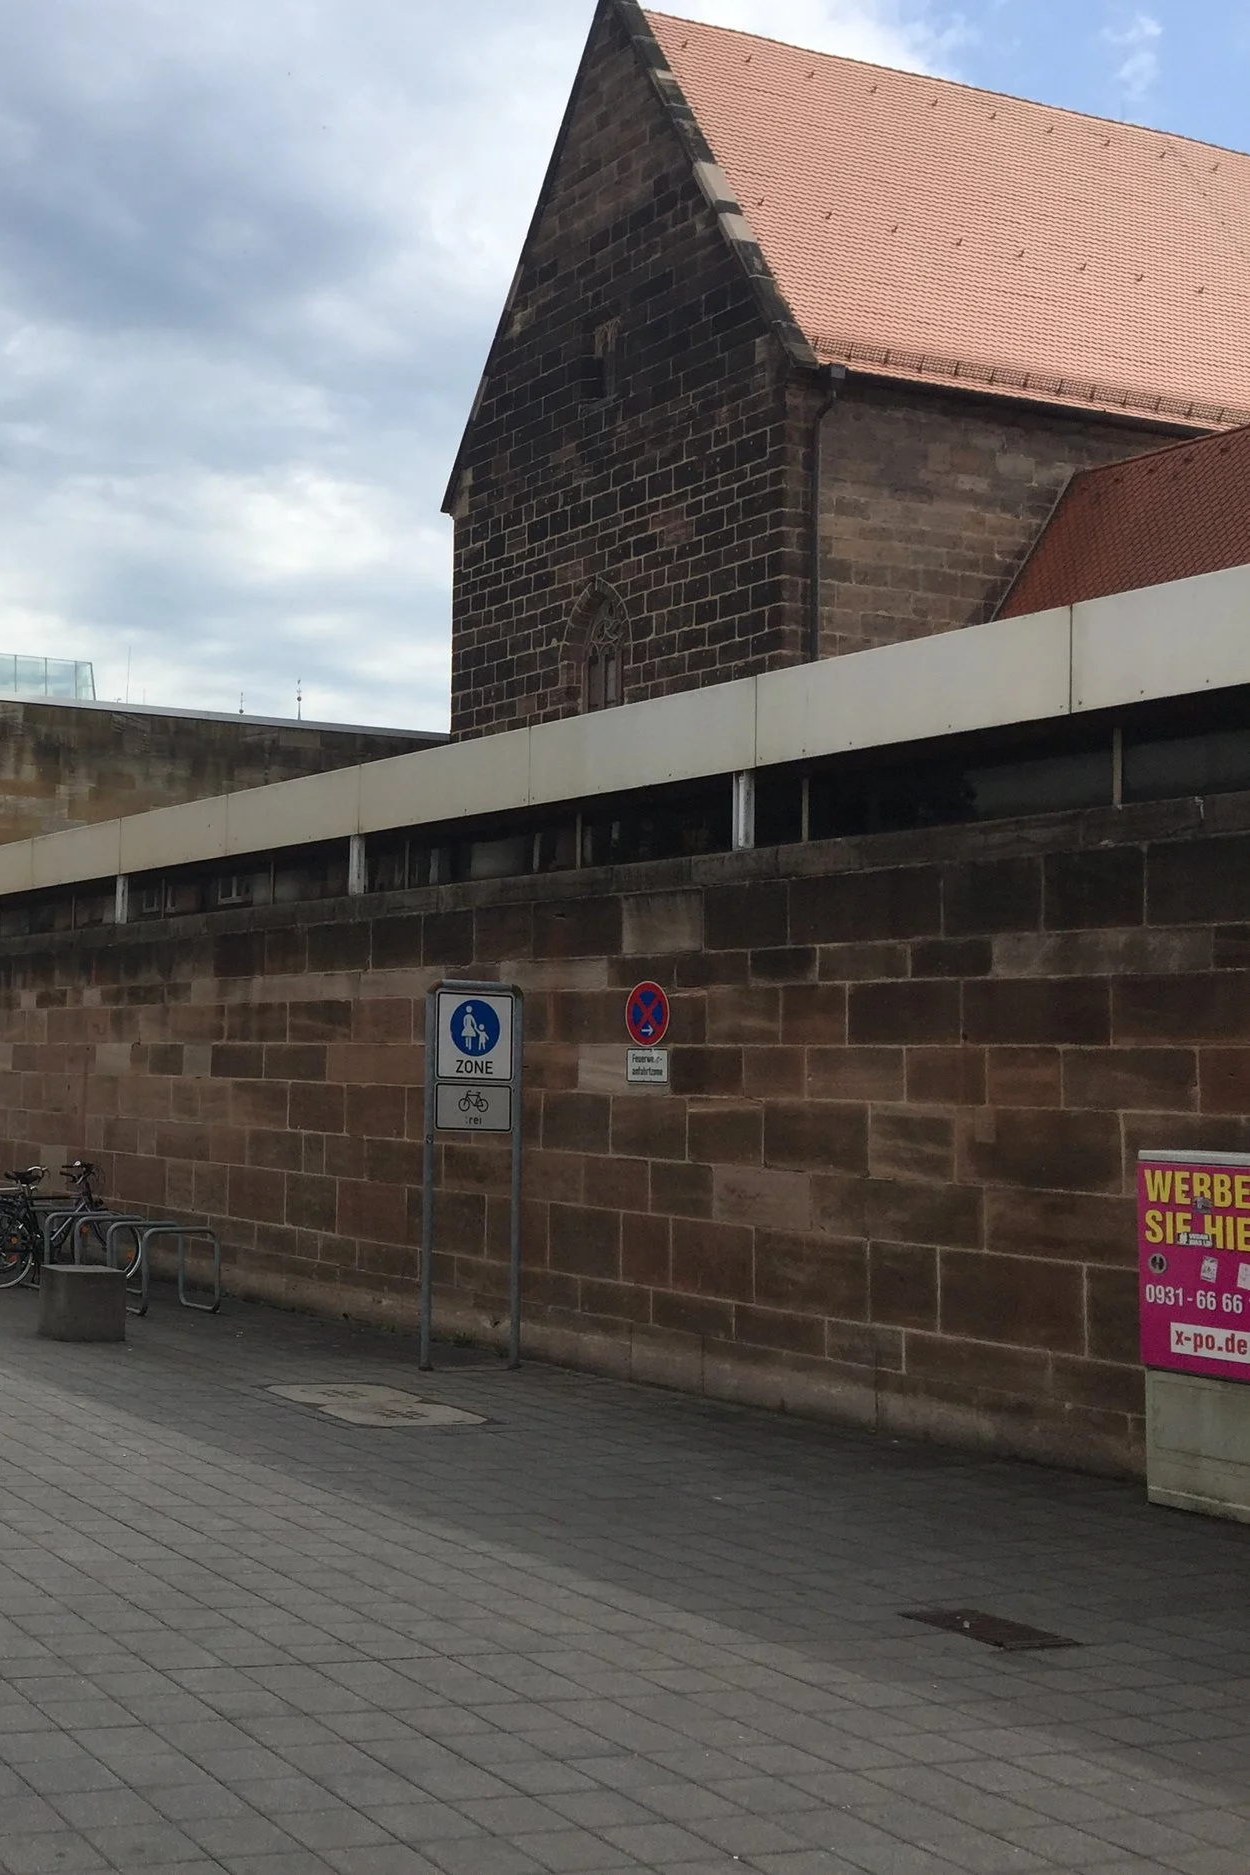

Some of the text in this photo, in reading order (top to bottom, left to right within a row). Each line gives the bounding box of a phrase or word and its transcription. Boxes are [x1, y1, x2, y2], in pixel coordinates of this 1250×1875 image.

[456, 1059, 493, 1075] ZONE
[1144, 1169, 1250, 1209] WERBE
[1145, 1209, 1192, 1244] SIE
[1204, 1214, 1250, 1252] HIE
[1145, 1284, 1183, 1307] 0931
[1222, 1293, 1243, 1315] 66
[1175, 1330, 1248, 1356] x-po.de
